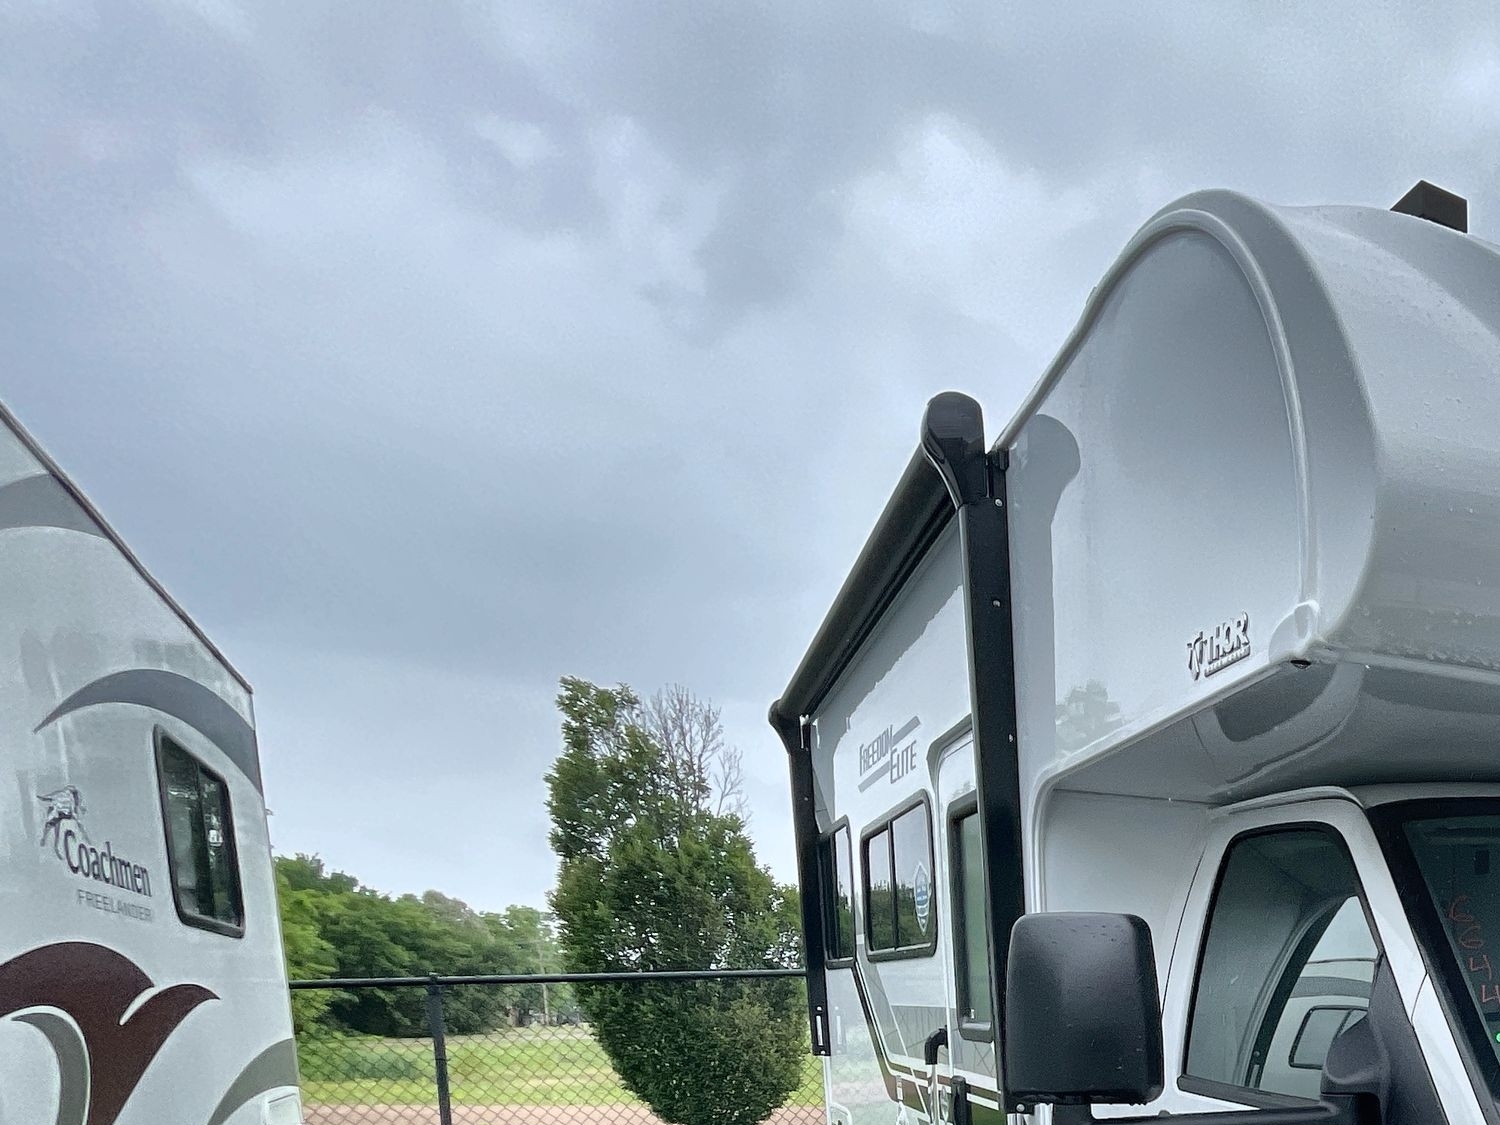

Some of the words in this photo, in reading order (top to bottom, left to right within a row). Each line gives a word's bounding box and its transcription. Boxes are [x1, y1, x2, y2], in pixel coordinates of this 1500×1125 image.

[859, 723, 893, 777] FREEDOM
[889, 739, 917, 785] ELITE
[64, 829, 153, 898] Coachmen
